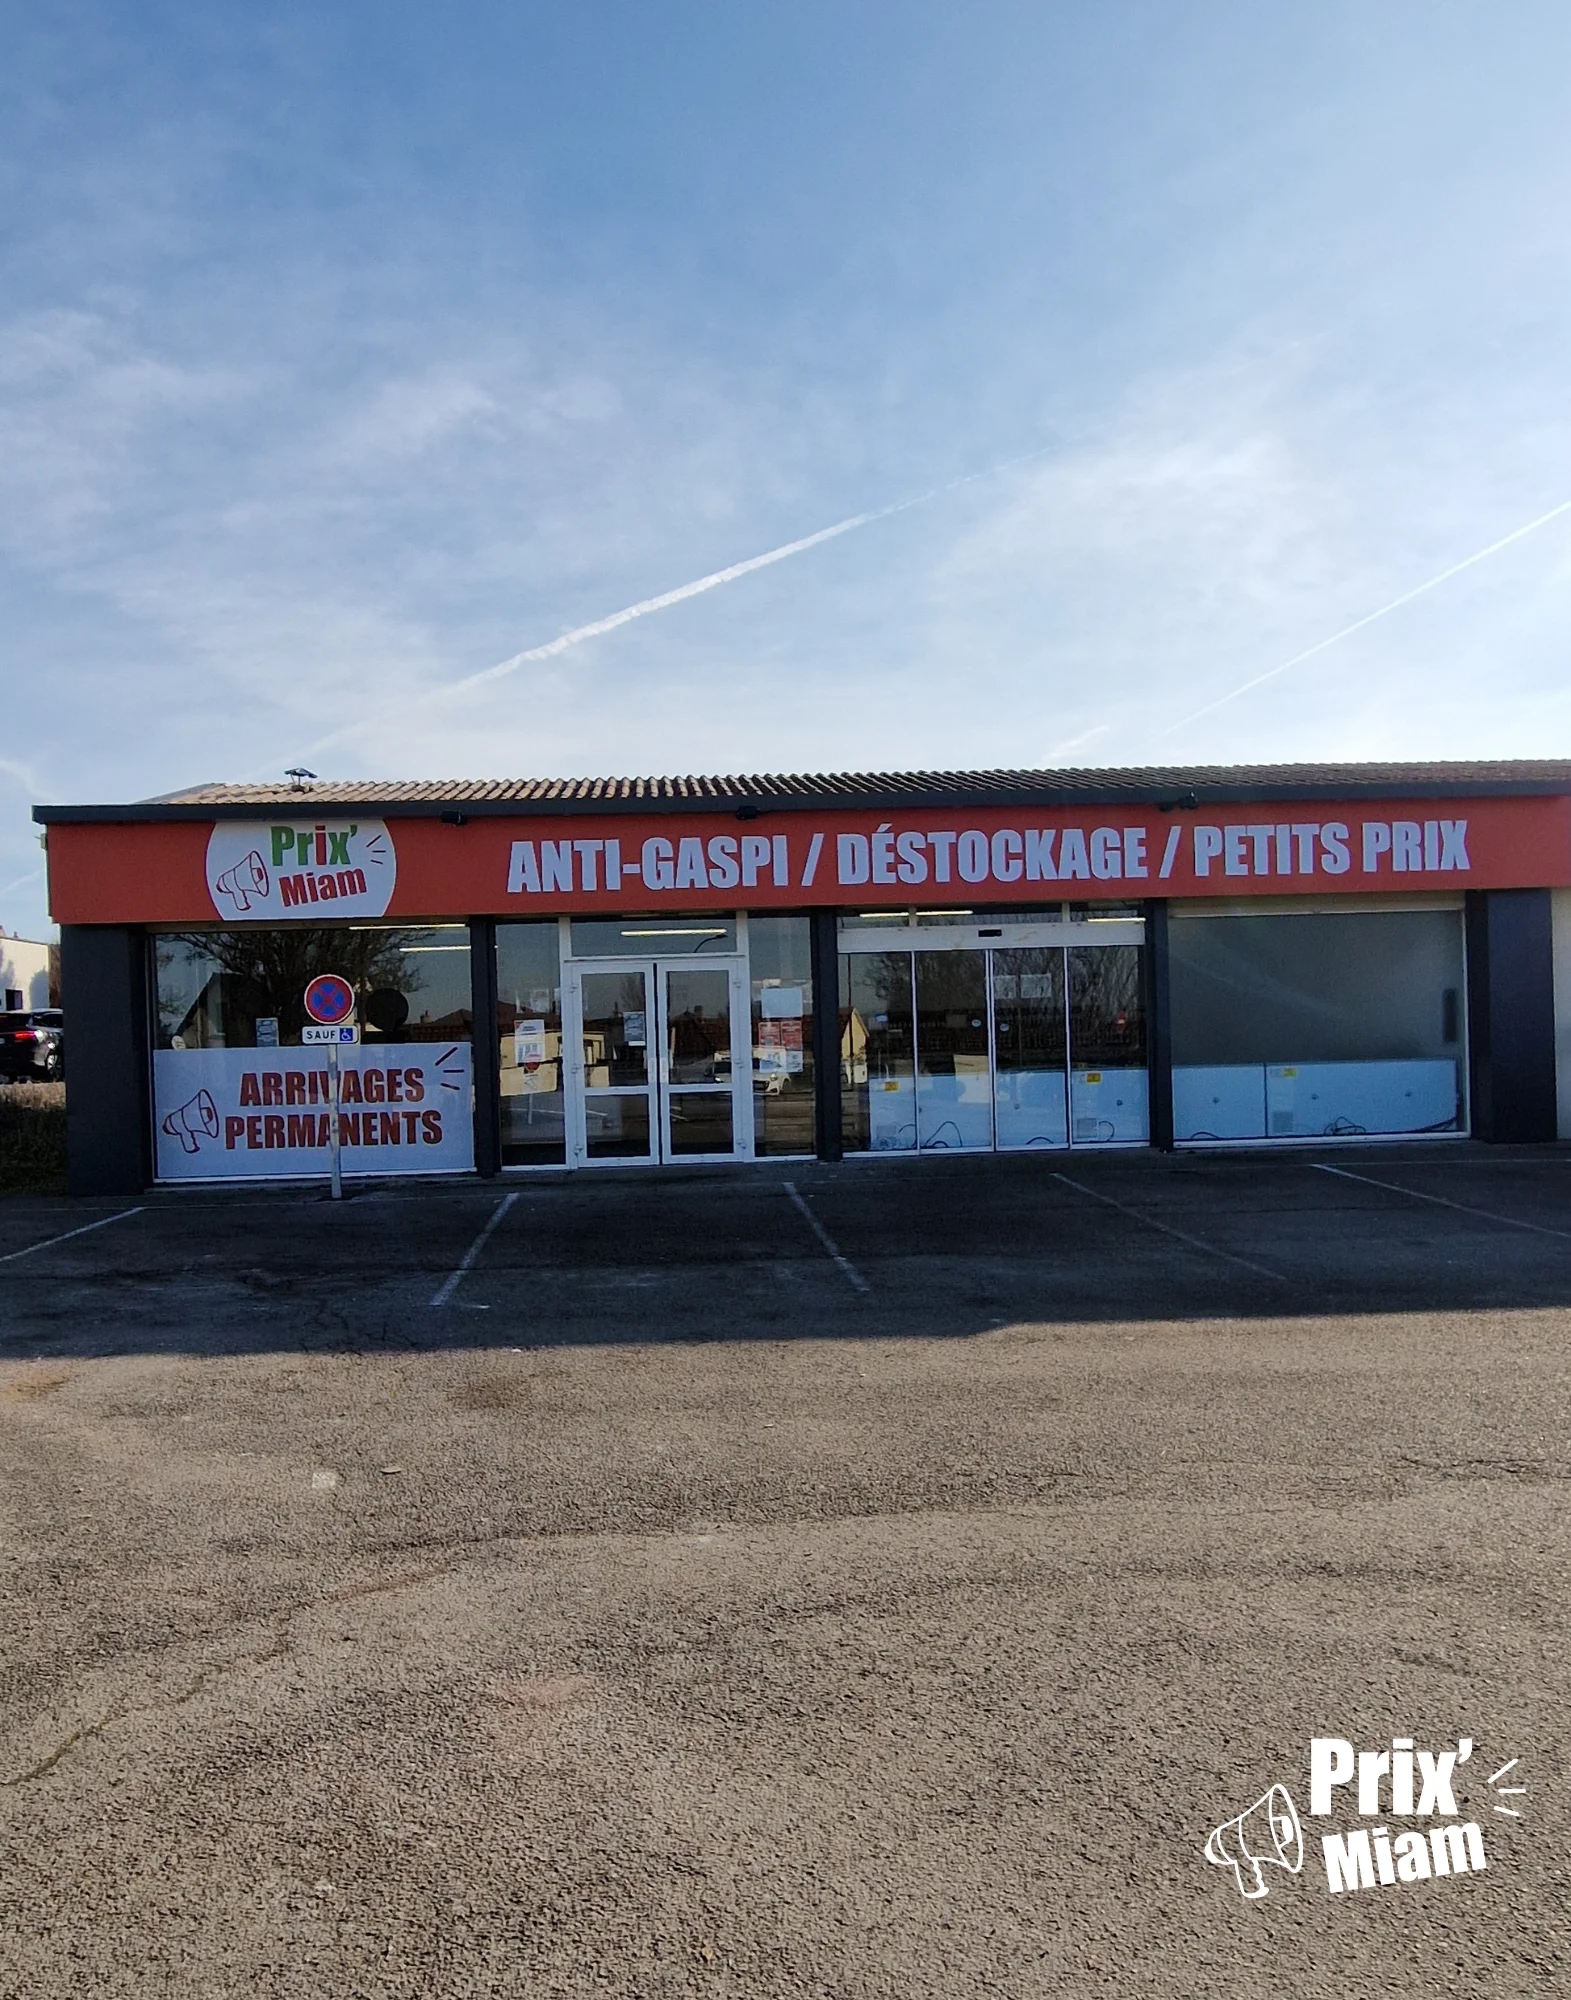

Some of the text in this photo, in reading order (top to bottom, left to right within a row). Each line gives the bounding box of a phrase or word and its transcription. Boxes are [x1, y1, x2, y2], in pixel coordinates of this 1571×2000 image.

[271, 825, 357, 867] Prix'
[507, 820, 1471, 893] ANTI-GASPI / DÉSTOCKAGE / PETITS PRIX
[279, 867, 367, 907] Miam
[306, 1030, 336, 1040] SAUF
